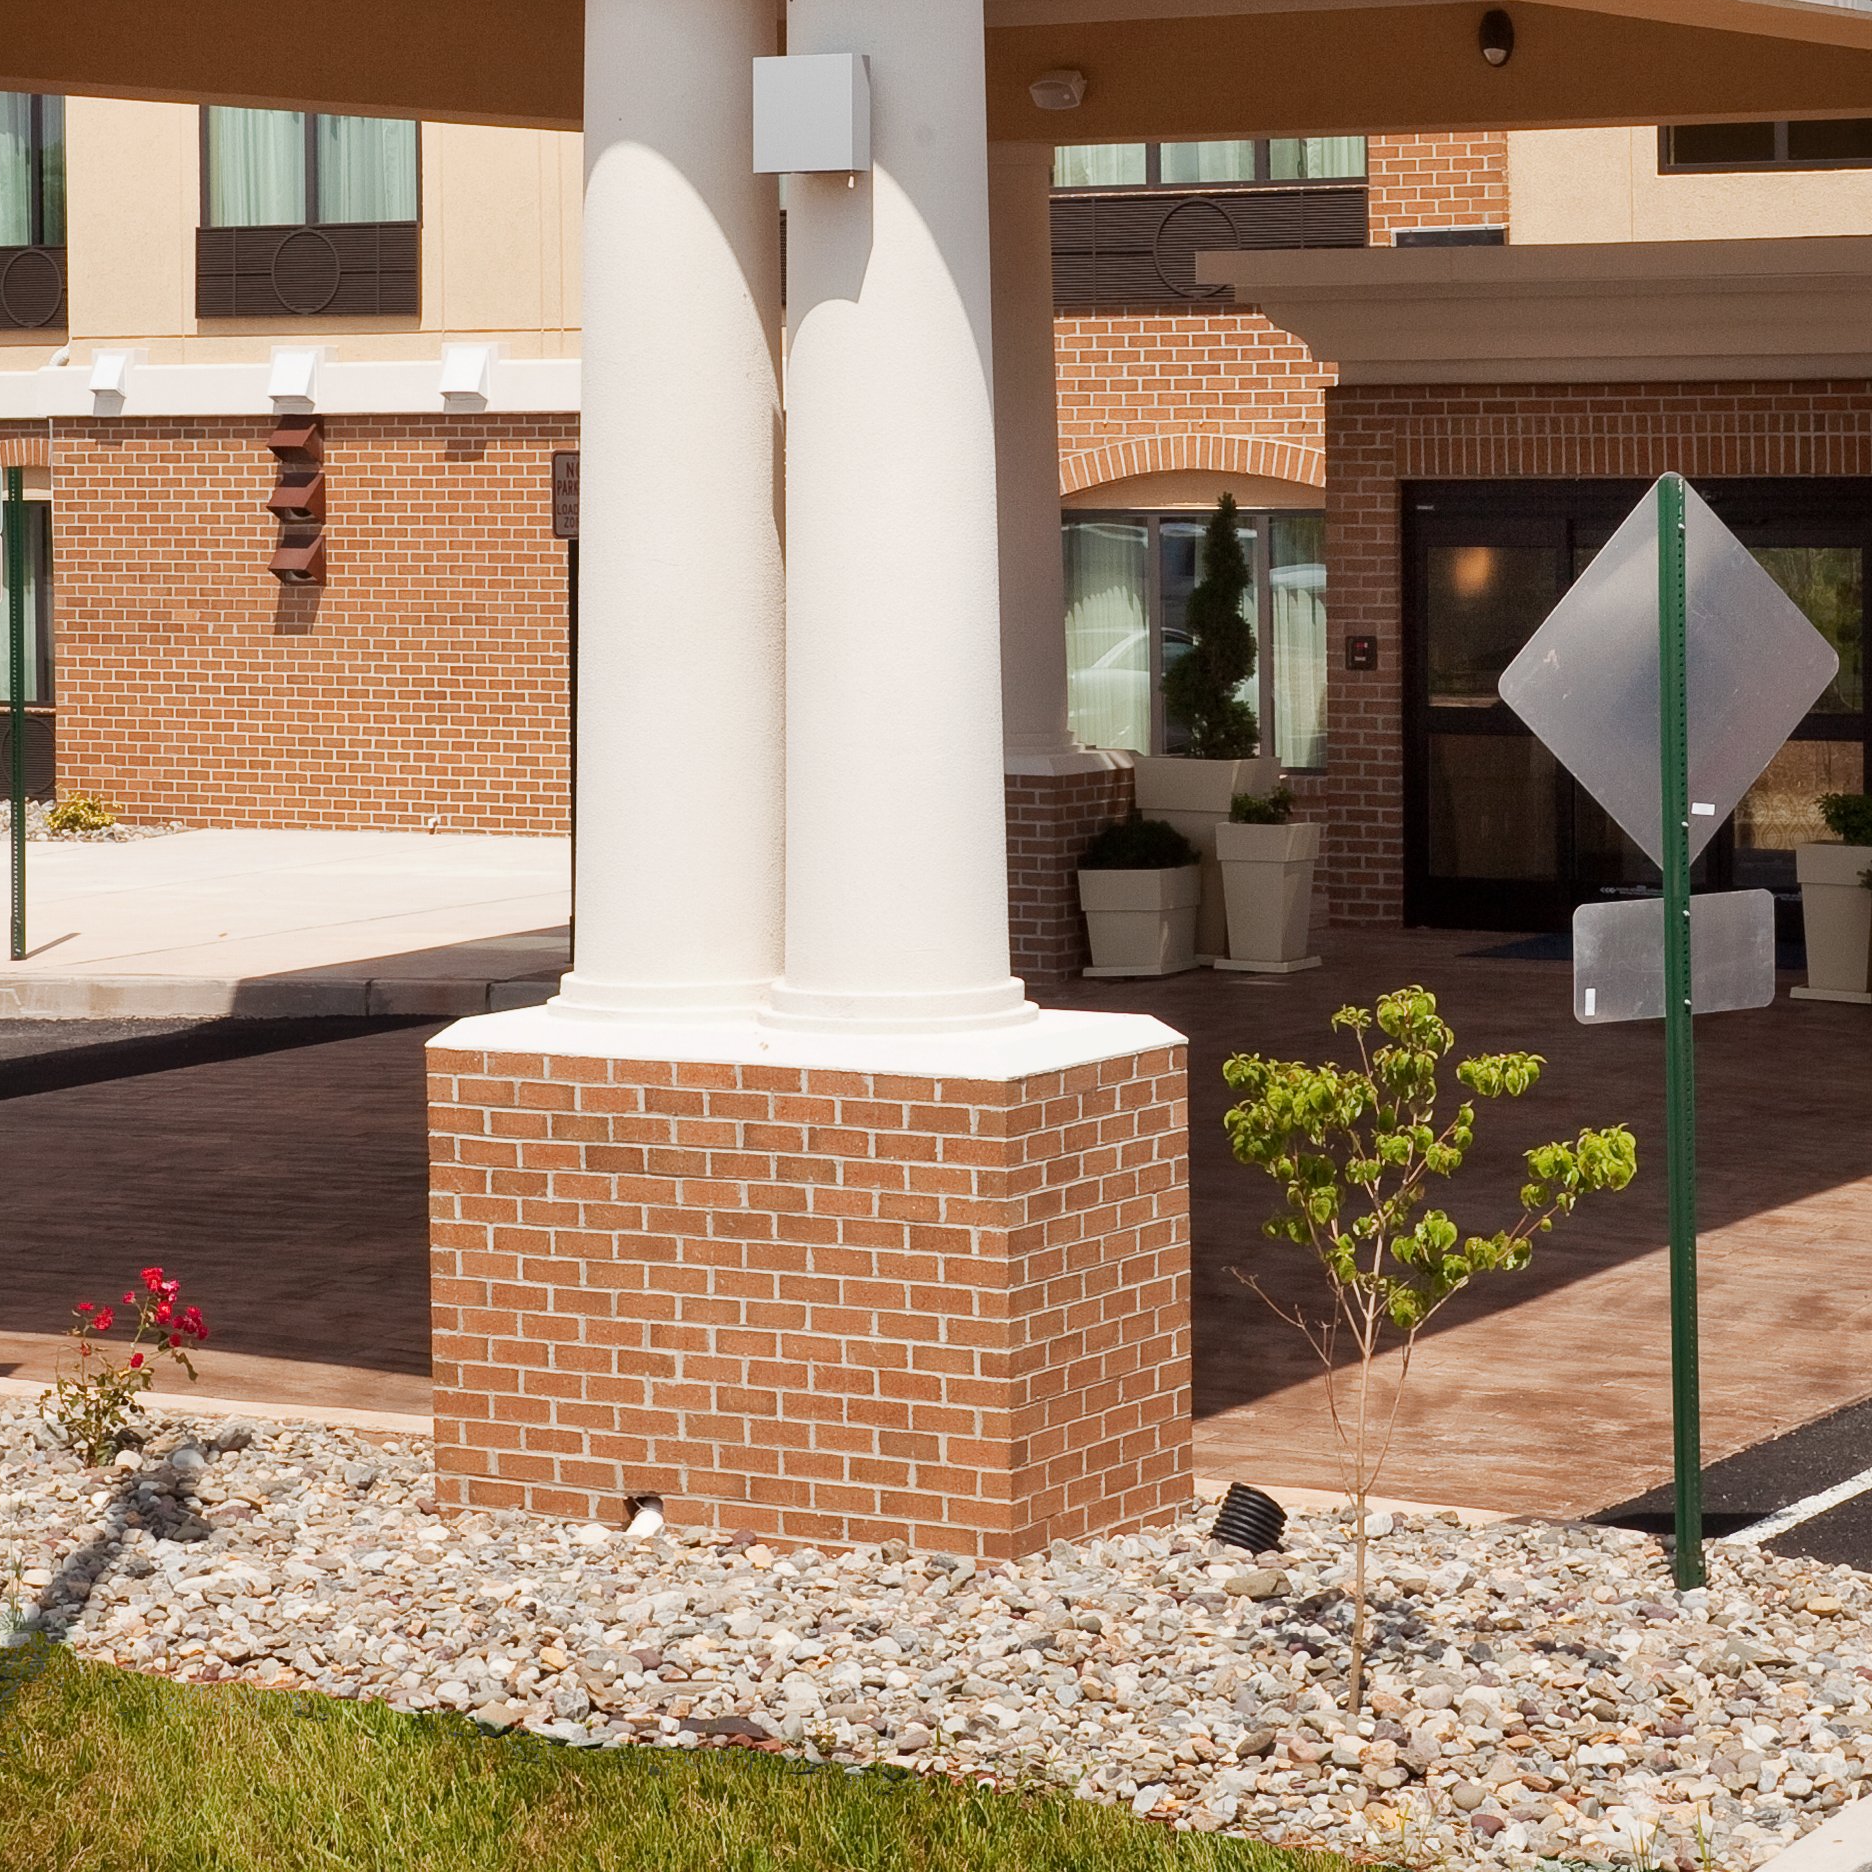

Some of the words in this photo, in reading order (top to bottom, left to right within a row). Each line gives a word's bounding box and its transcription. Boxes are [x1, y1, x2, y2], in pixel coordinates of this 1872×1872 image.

[557, 480, 579, 496] PARK
[557, 504, 579, 515] LOAD
[564, 517, 579, 528] ZO
